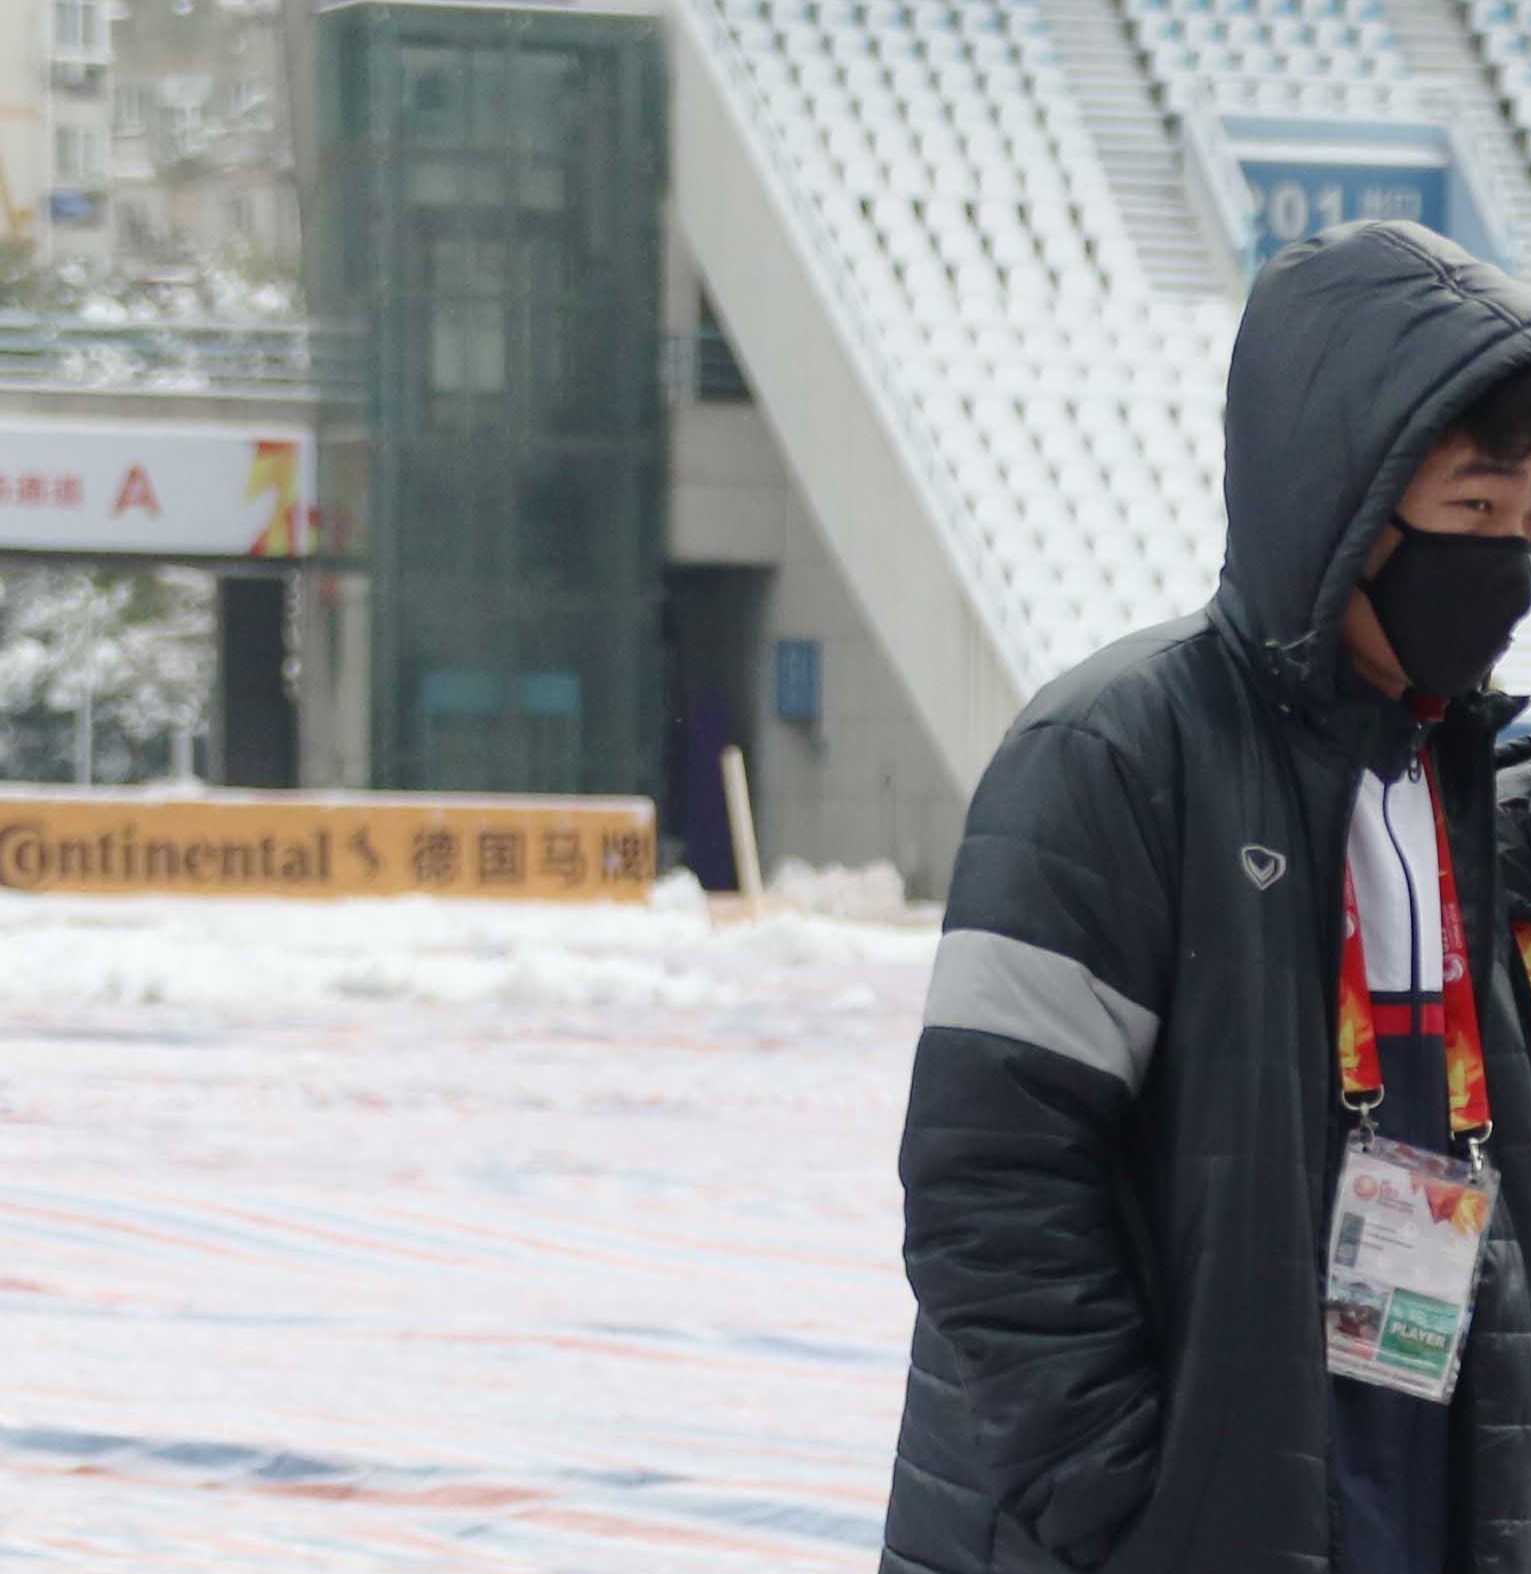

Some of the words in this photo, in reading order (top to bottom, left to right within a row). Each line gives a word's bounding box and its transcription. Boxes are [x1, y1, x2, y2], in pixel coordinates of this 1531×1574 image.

[111, 460, 162, 518] A
[0, 822, 333, 888] Continental
[1391, 1321, 1447, 1349] PLAYER
